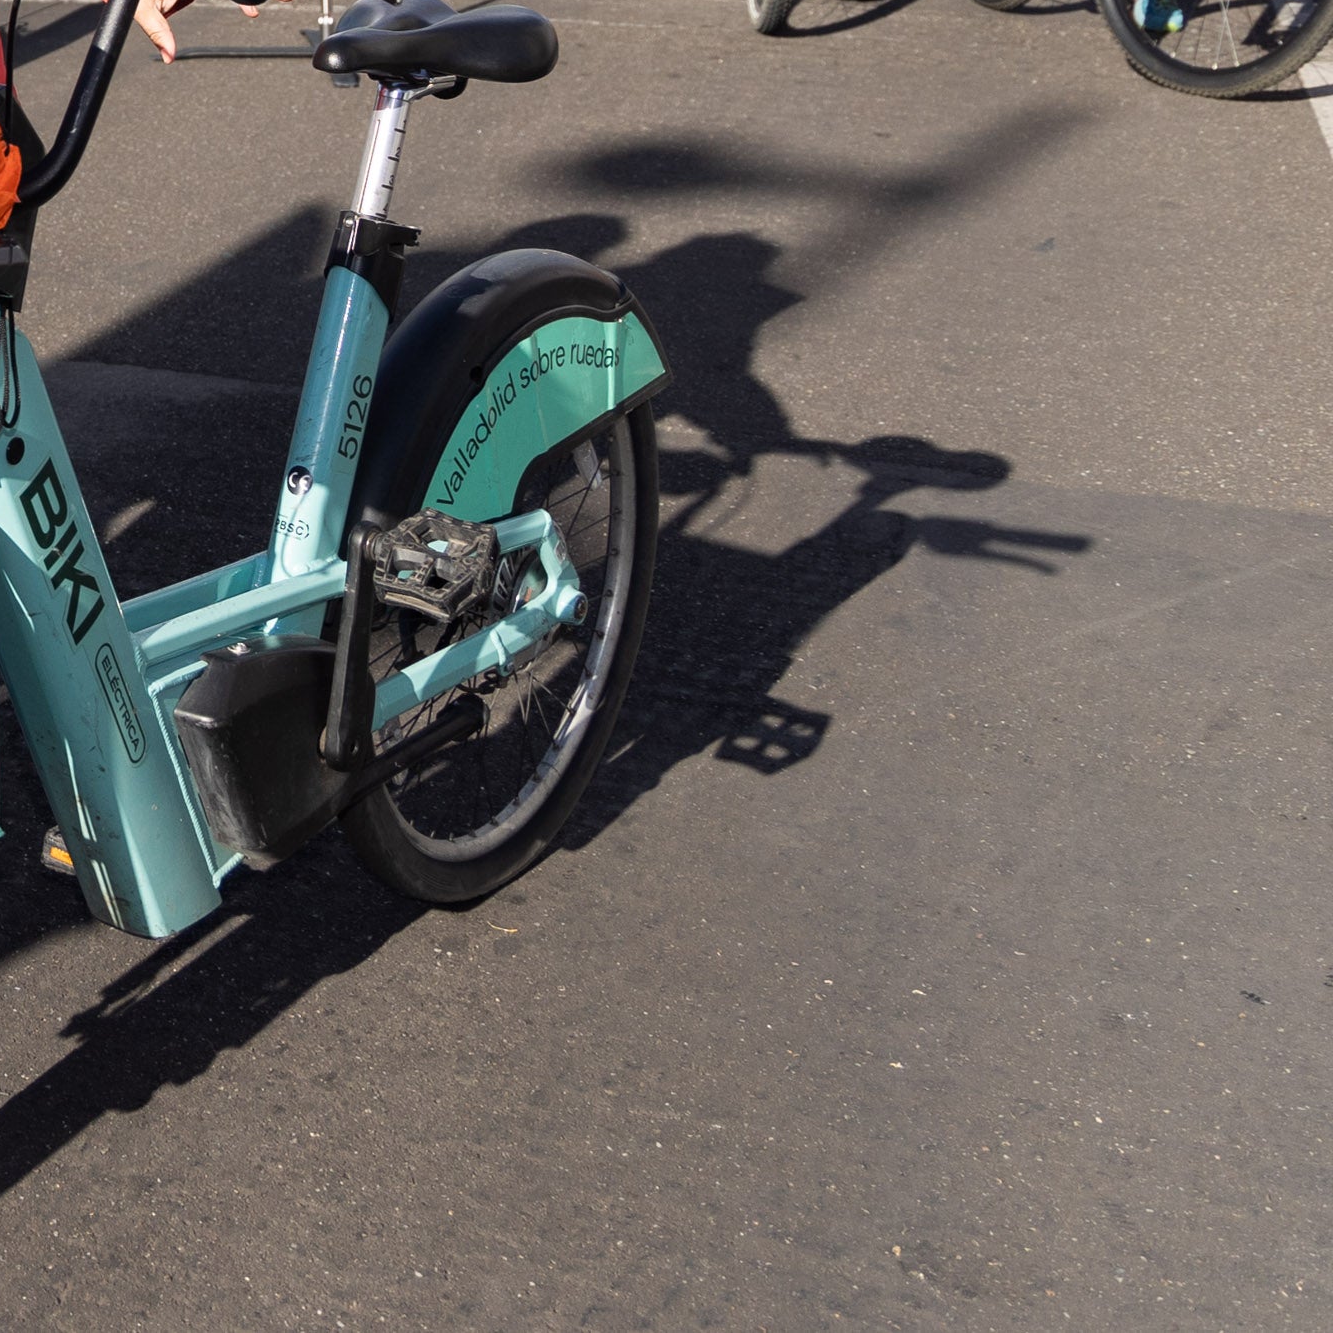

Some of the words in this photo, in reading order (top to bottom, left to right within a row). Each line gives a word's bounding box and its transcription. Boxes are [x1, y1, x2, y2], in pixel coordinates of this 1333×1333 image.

[337, 373, 374, 460] 5126
[436, 376, 517, 508] Valladolid
[519, 345, 566, 390] sobre
[570, 340, 621, 368] ruedas
[19, 457, 105, 645] BIKI
[101, 654, 140, 752] ELÉCTRICA
